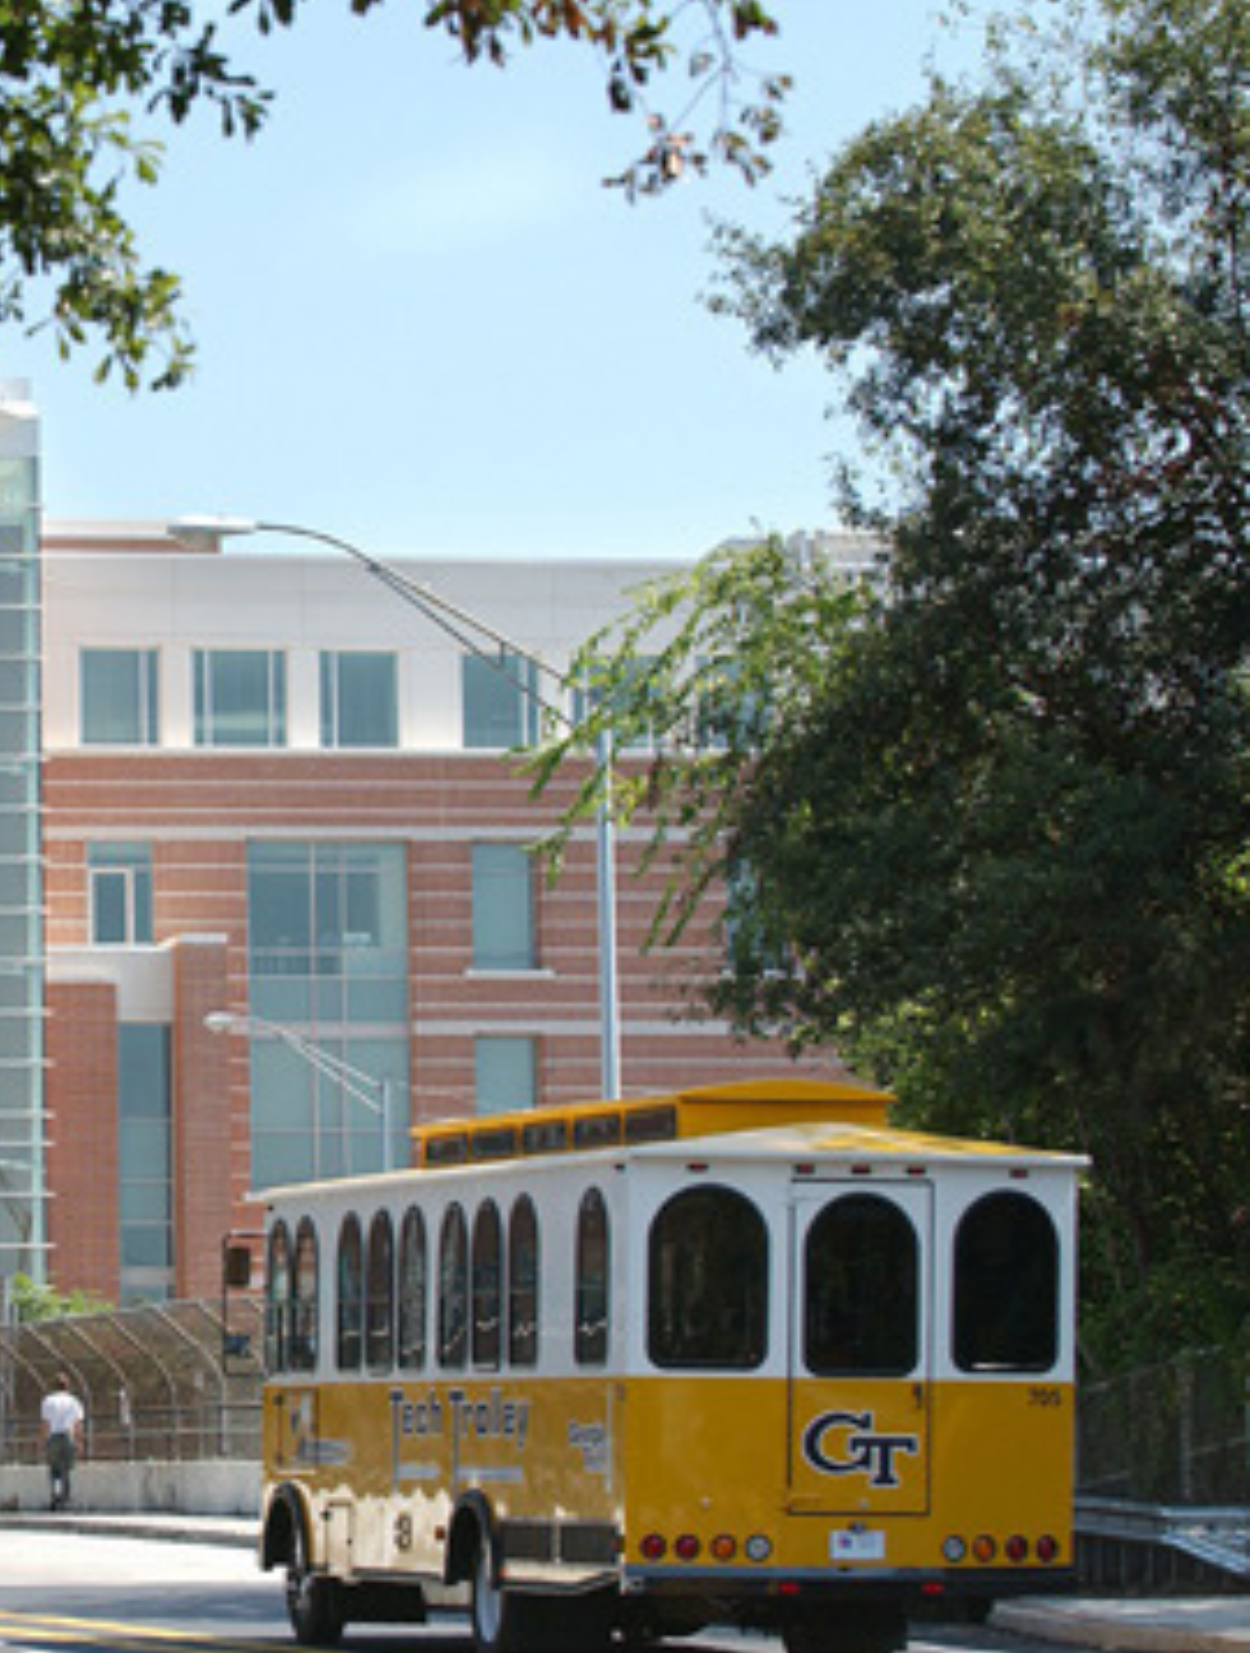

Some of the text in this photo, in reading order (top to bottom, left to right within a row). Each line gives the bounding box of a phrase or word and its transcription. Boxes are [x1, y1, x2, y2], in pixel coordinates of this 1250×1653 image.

[387, 1386, 443, 1438] Tech
[447, 1386, 530, 1450] Trolley
[801, 1409, 919, 1489] GT
